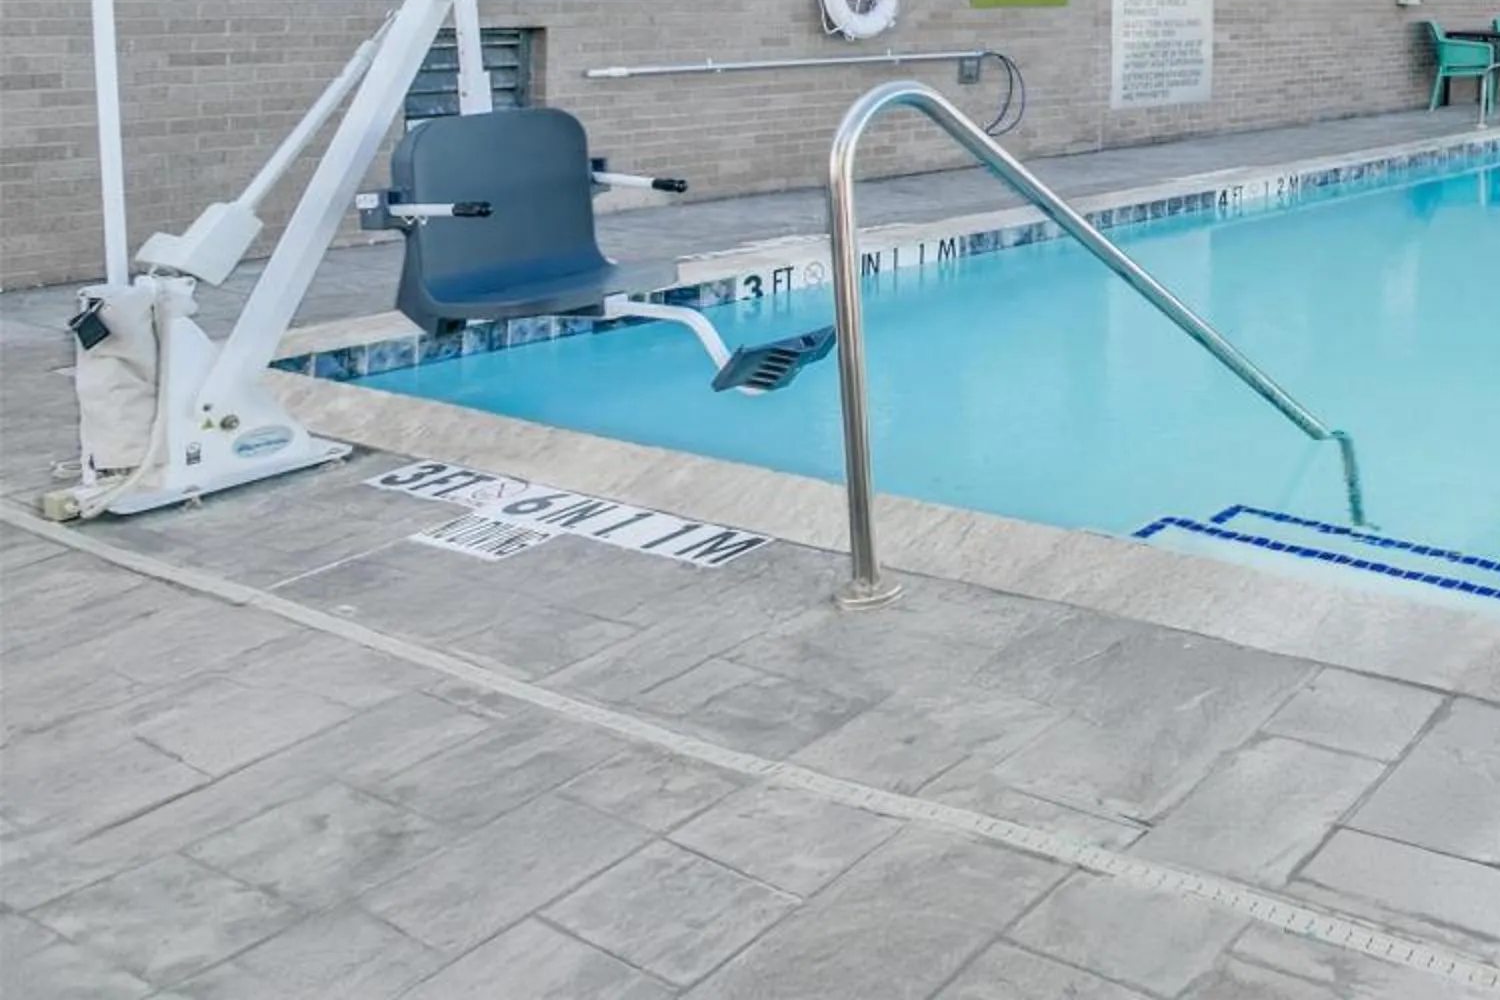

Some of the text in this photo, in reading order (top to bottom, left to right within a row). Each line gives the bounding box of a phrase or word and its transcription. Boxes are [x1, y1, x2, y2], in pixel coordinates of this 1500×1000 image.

[742, 275, 763, 300] 3
[773, 266, 794, 295] FT
[862, 251, 881, 277] IN
[938, 237, 957, 262] M
